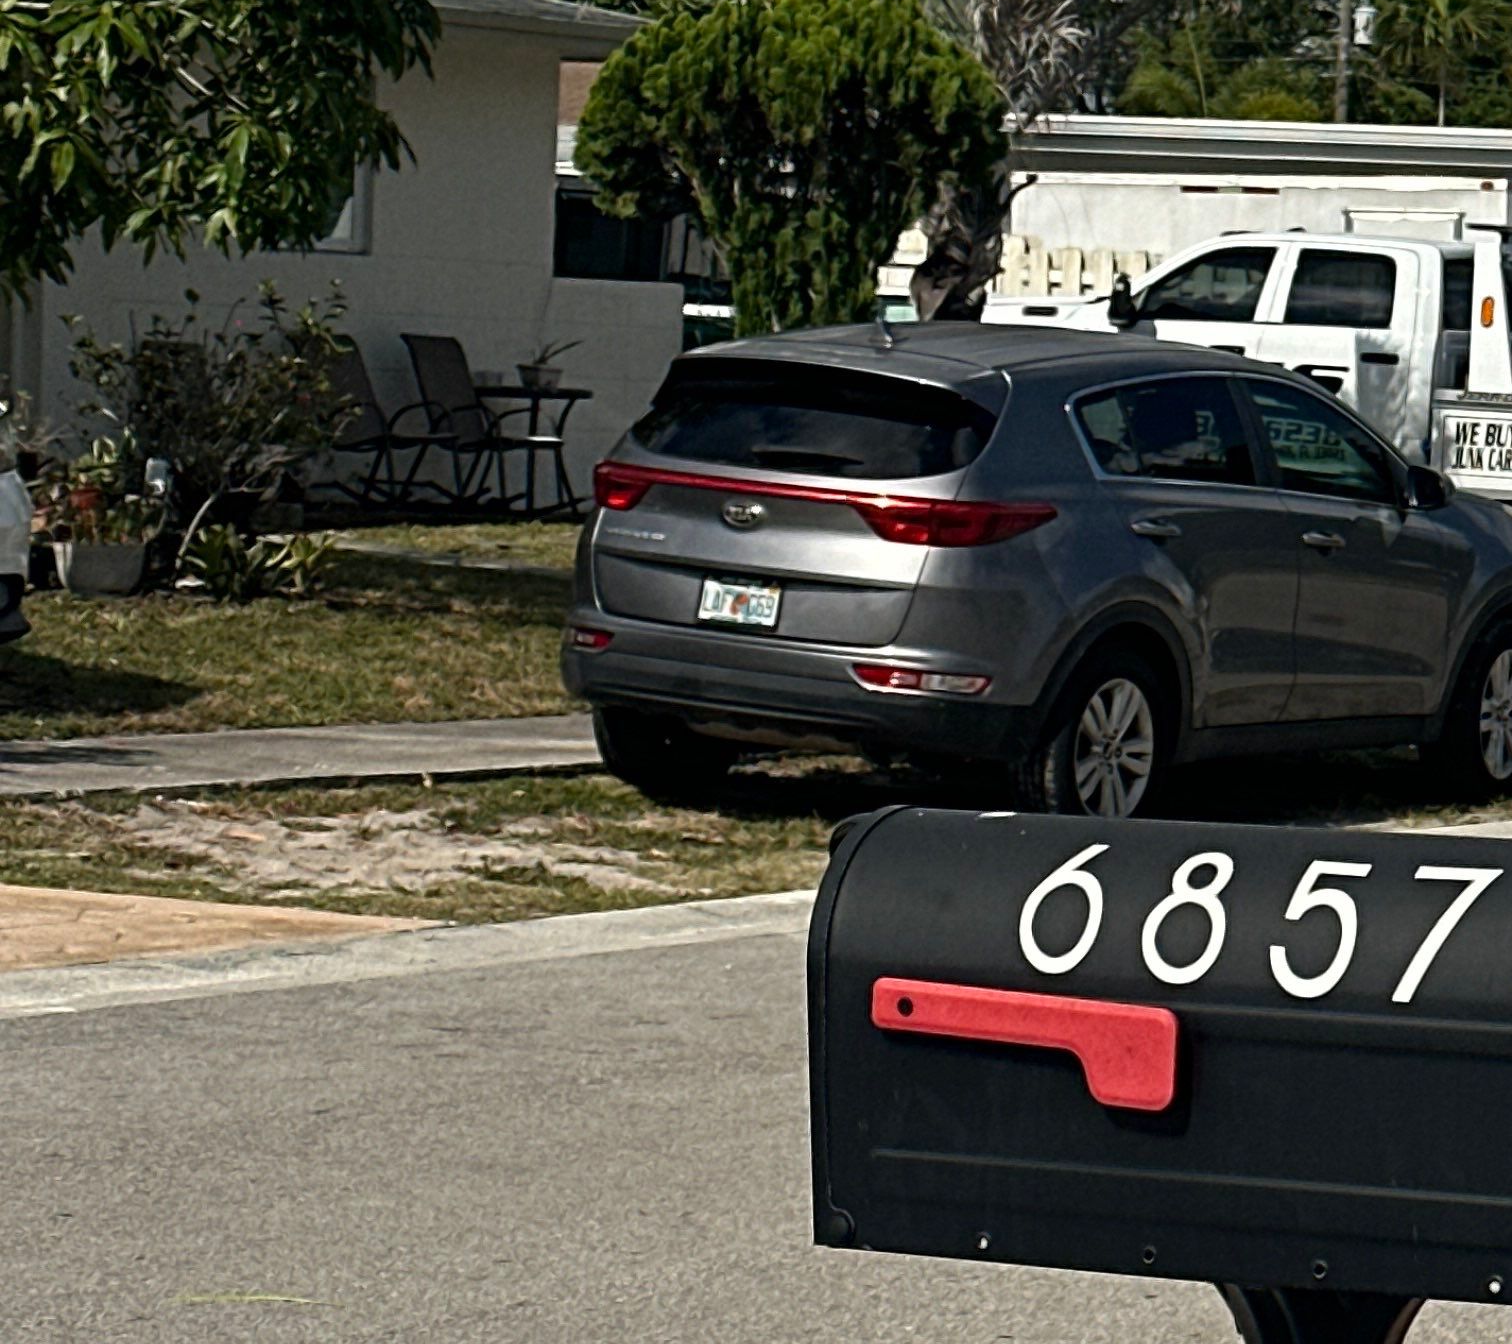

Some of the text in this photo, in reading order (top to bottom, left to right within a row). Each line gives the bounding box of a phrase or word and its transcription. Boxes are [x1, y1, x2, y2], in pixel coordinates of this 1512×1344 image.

[1455, 421, 1481, 446] WE
[1451, 447, 1485, 470] JUNK
[1018, 843, 1505, 1004] 6857
